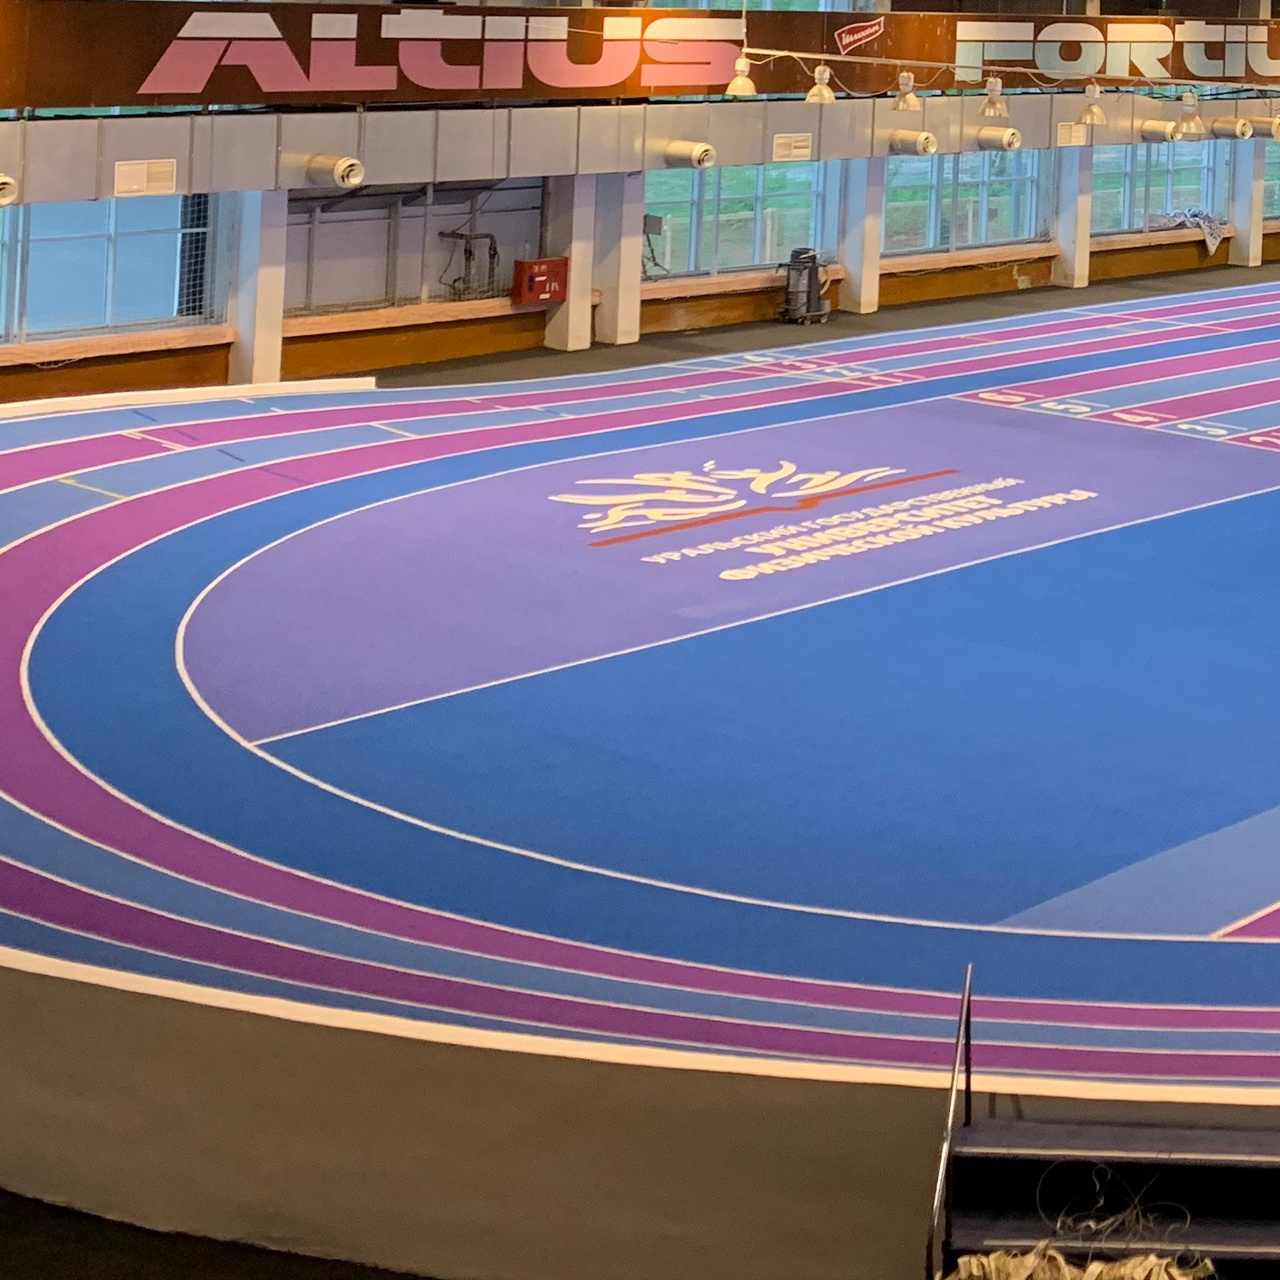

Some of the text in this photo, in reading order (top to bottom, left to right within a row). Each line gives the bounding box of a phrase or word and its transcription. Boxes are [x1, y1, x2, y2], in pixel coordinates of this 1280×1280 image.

[978, 392, 1026, 403] 6
[1040, 402, 1092, 414] 5
[1112, 412, 1160, 423] 4
[1177, 423, 1228, 436] 3
[744, 494, 1004, 556] УНИВЕРСИТЕТ
[719, 488, 1099, 581] ФИЗИЧЕСКОЙ КУЛЬТУРЫ
